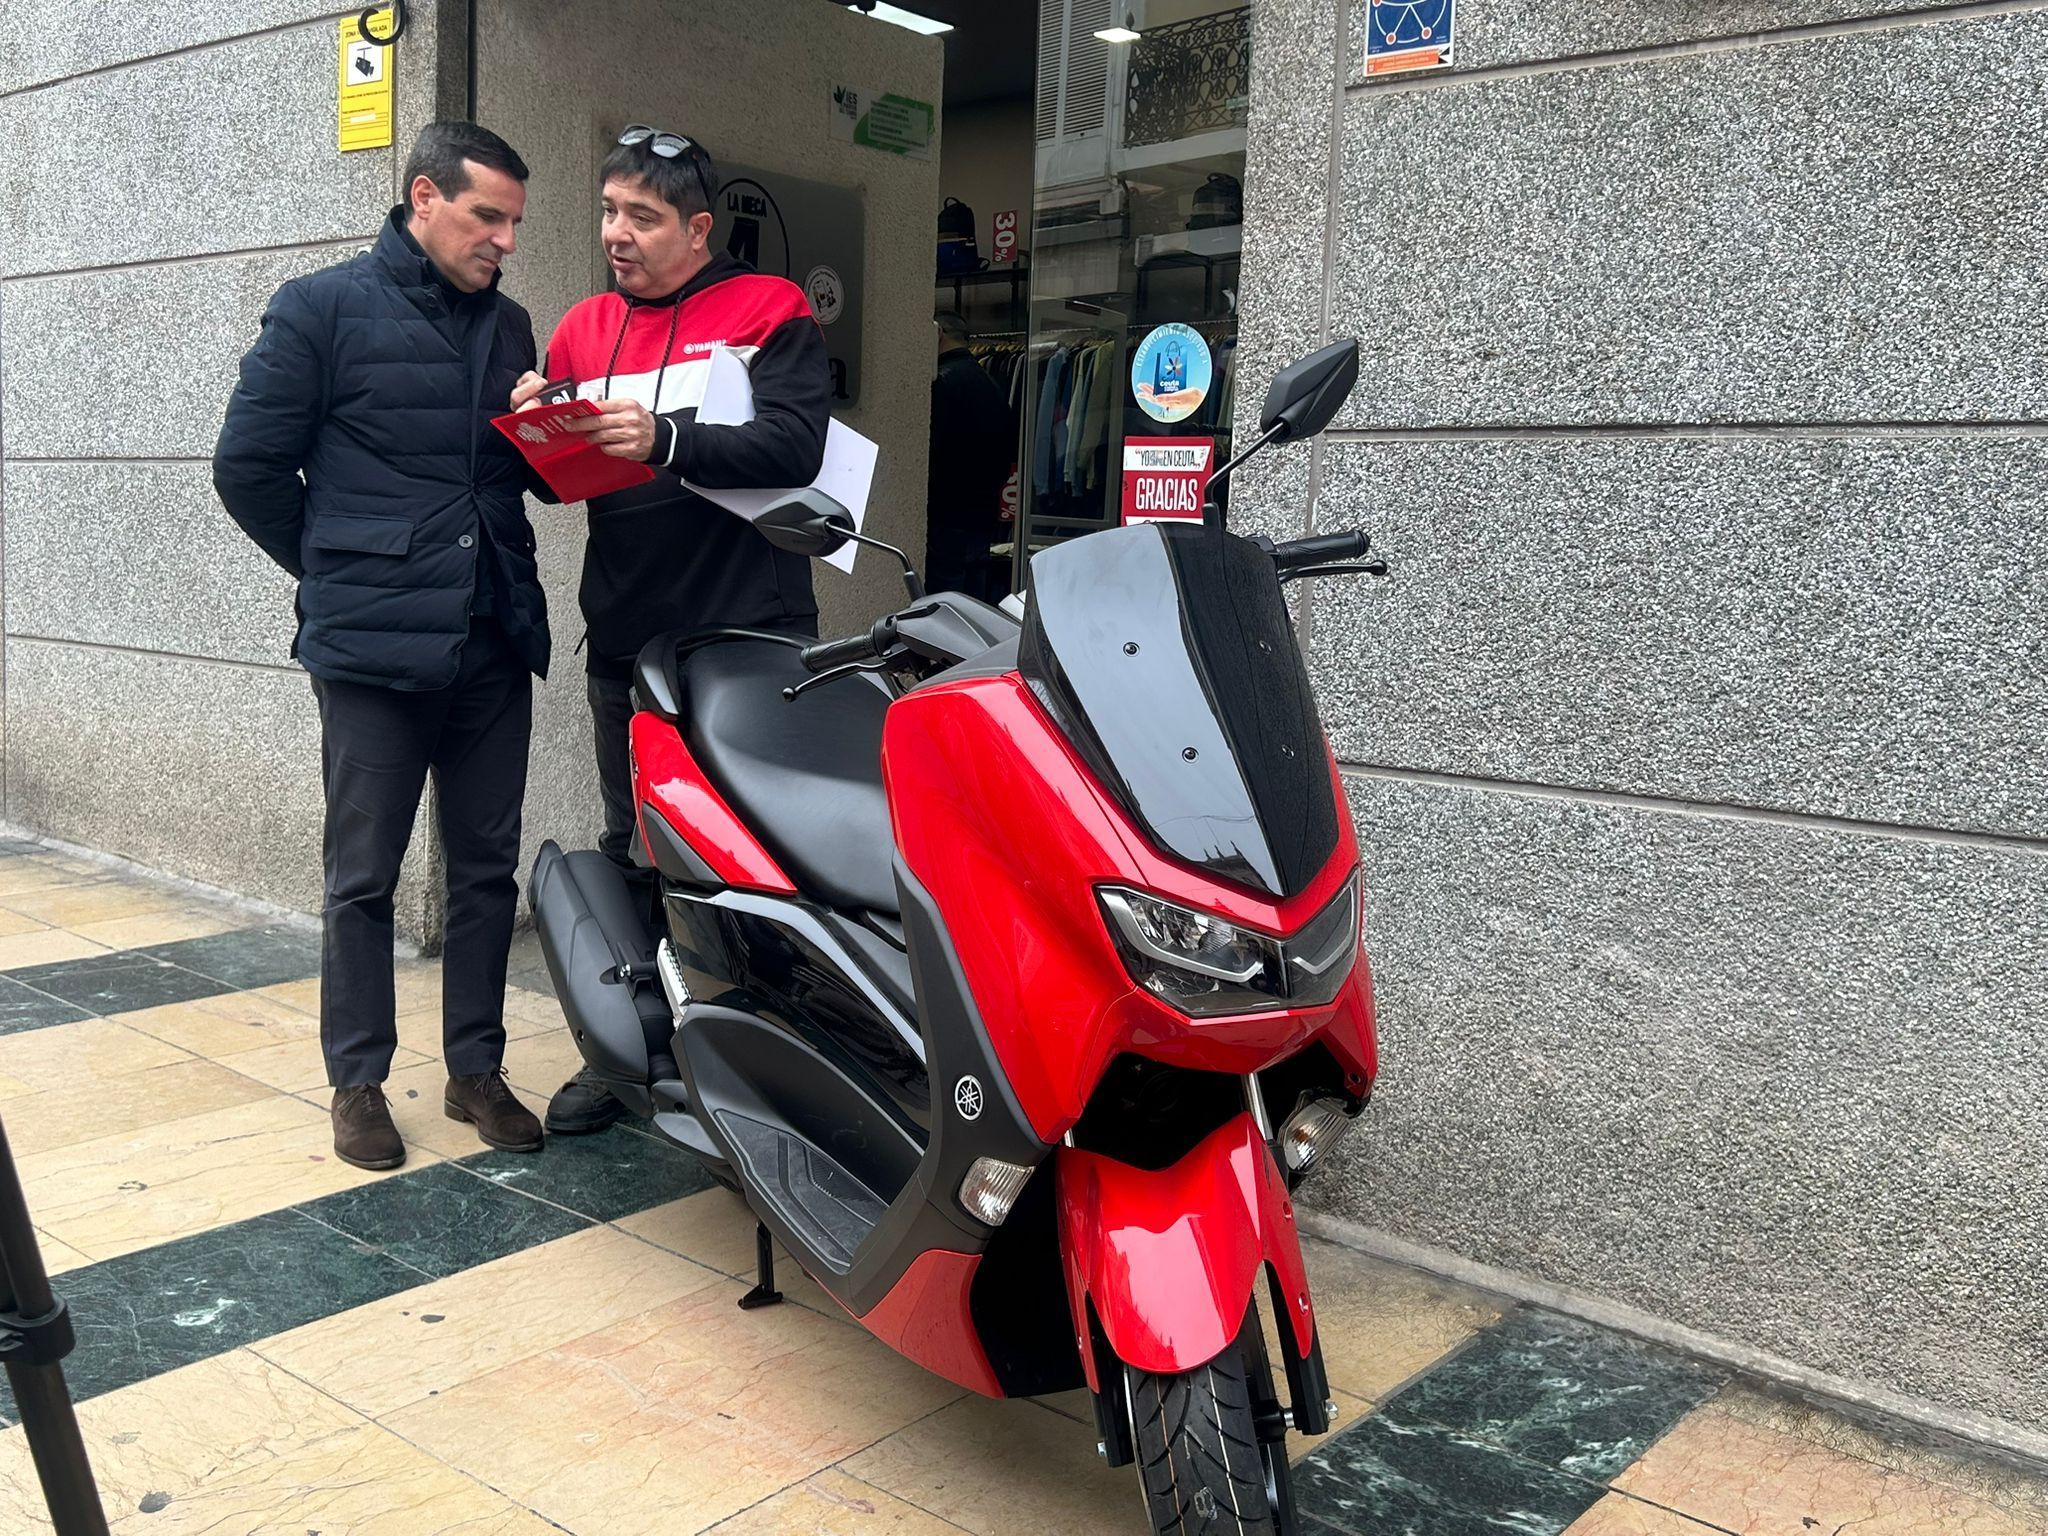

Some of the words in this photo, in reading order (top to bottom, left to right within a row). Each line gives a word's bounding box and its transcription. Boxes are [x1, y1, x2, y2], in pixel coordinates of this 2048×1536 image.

[727, 192, 740, 212] LA
[994, 211, 1016, 262] 30%
[1135, 477, 1199, 512] GRACIAS
